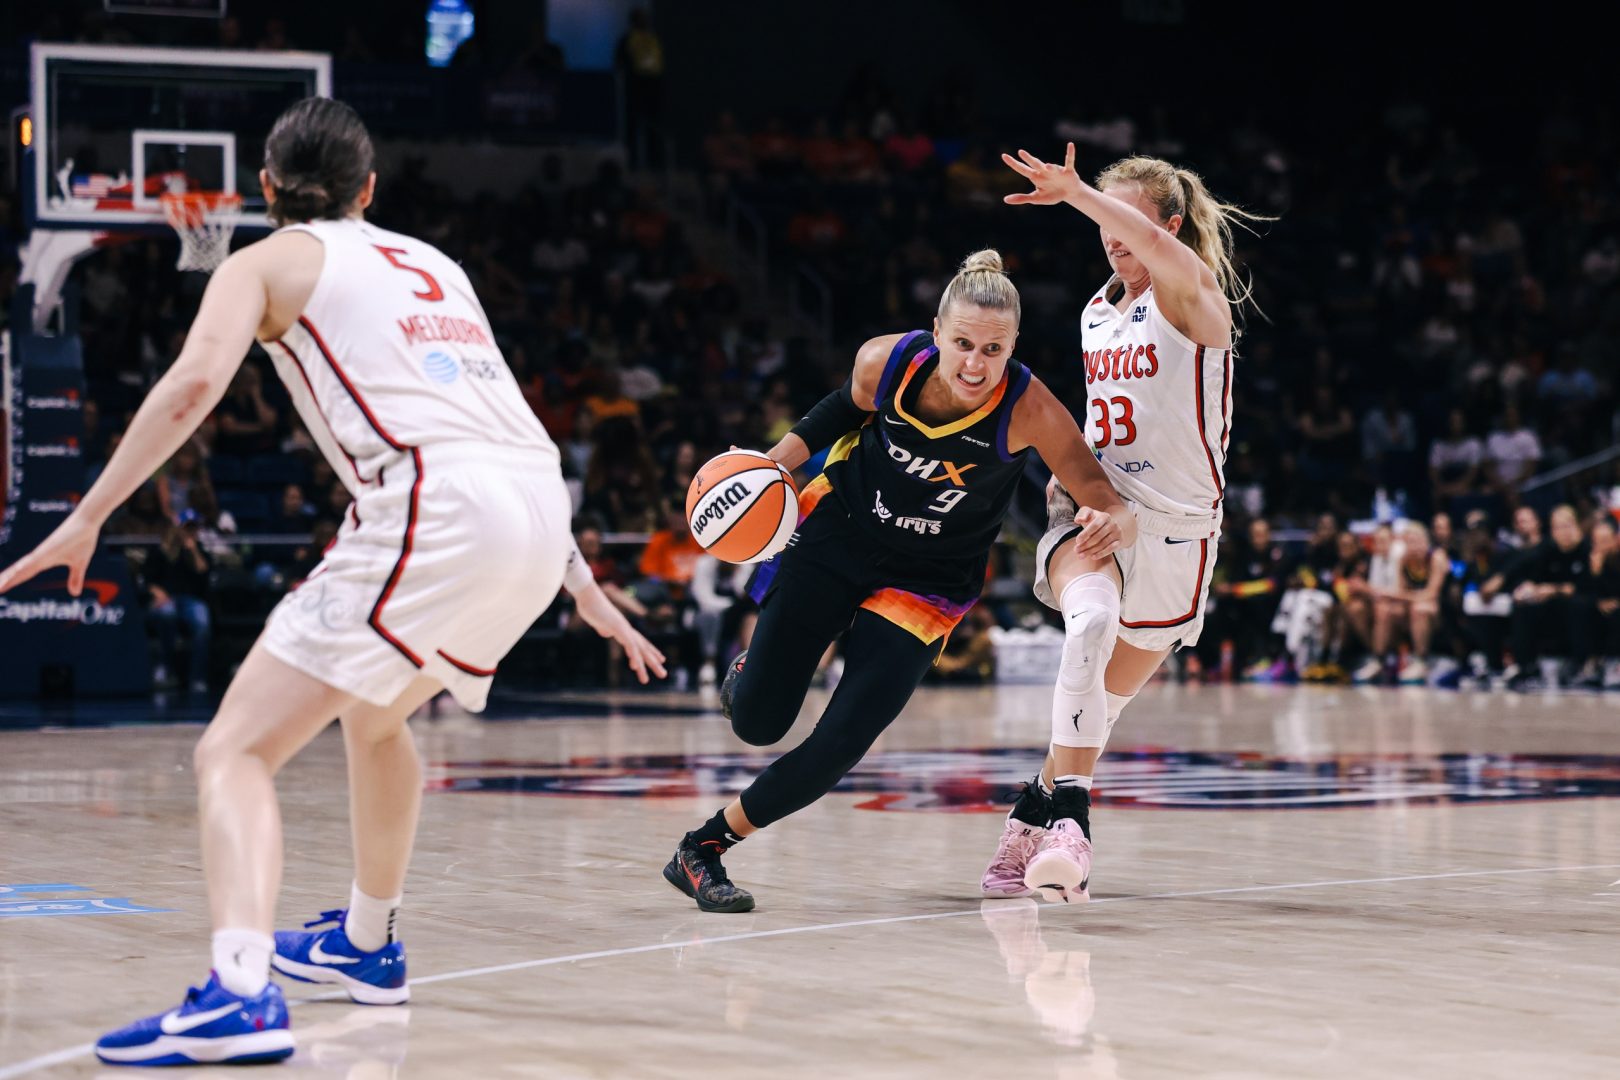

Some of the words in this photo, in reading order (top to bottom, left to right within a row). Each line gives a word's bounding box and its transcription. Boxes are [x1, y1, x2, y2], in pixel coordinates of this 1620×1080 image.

[370, 243, 444, 302] 5
[396, 314, 493, 348] MELBOURN
[1091, 396, 1137, 449] 33
[1114, 460, 1156, 473] NDA
[693, 481, 752, 536] Wilson
[928, 489, 968, 513] 9
